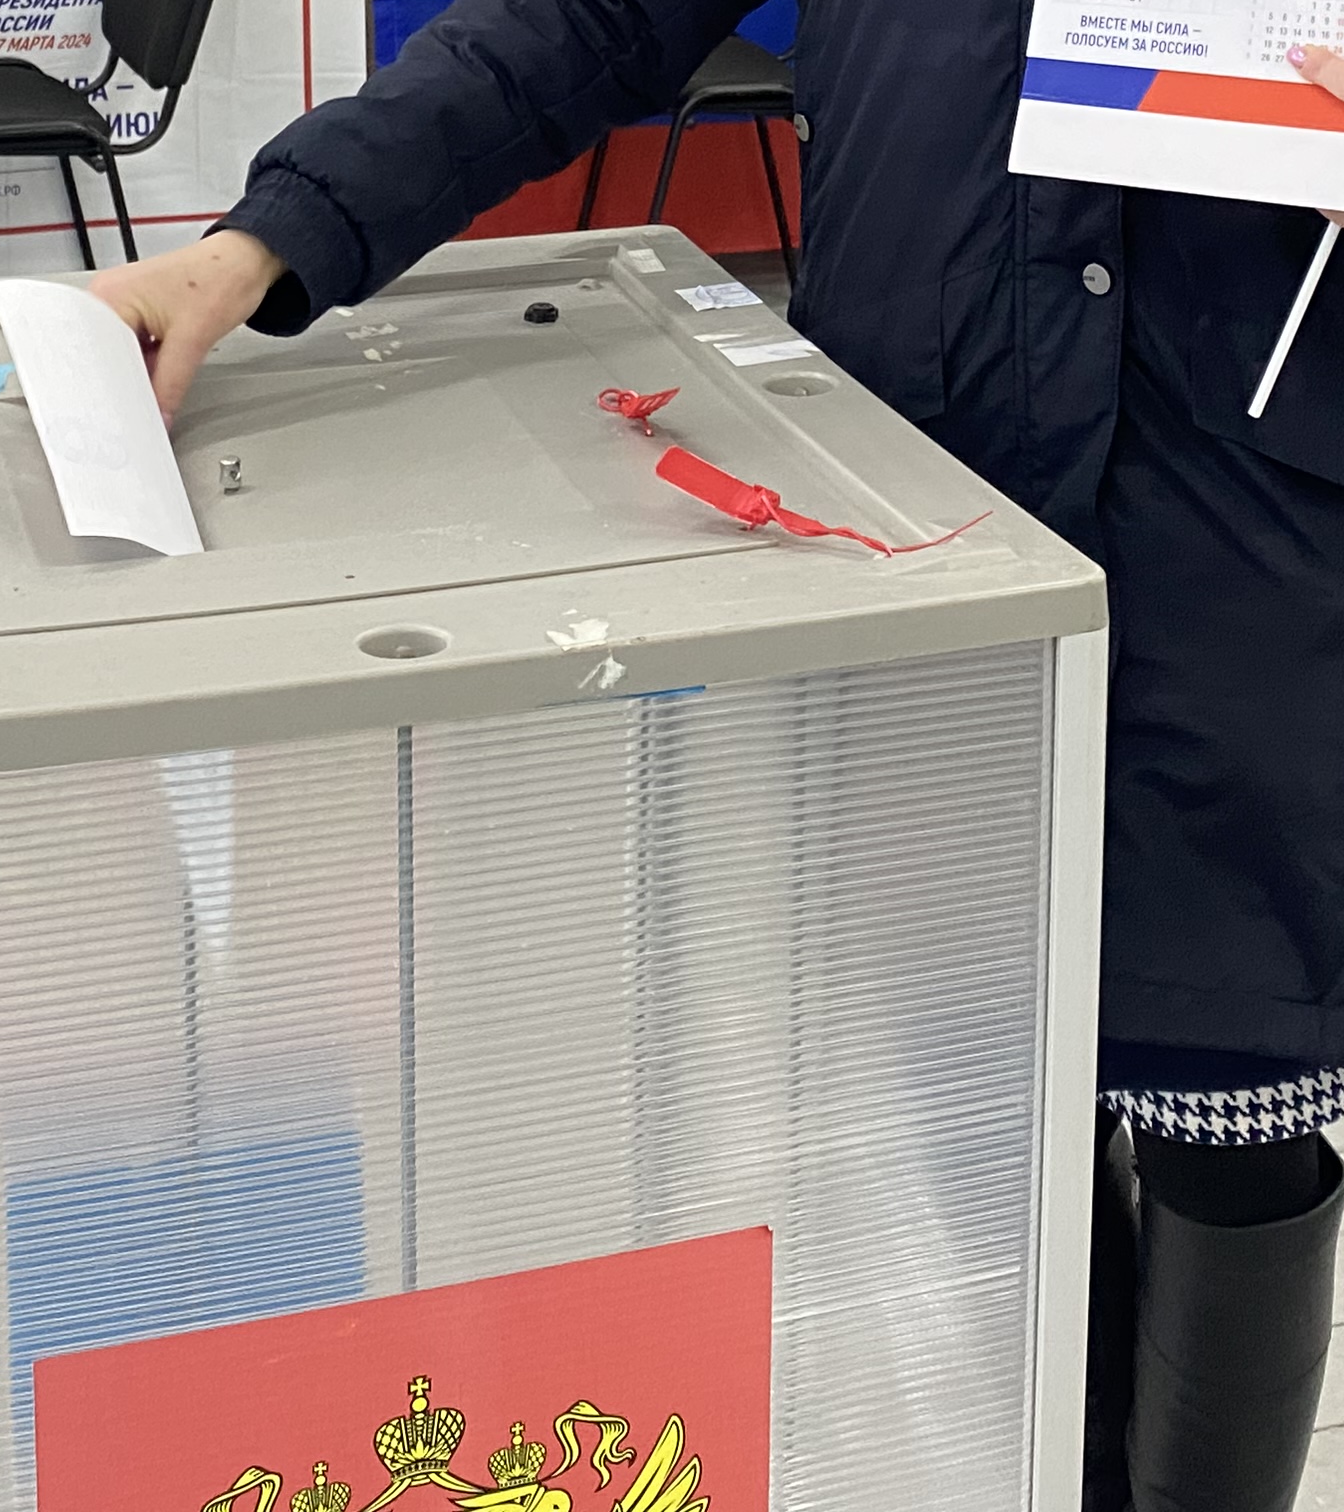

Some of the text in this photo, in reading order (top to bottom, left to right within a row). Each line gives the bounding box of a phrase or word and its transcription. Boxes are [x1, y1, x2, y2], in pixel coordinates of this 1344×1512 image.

[1081, 15, 1127, 30] ВМЕСТЕ
[1131, 20, 1152, 32] МЫ
[1156, 22, 1188, 36] СИЛА
[7, 36, 55, 52] МАРТА
[58, 33, 92, 49] 2024
[1065, 32, 1208, 56] ГОЛОСУЕМ ЗА РОССИЮ!
